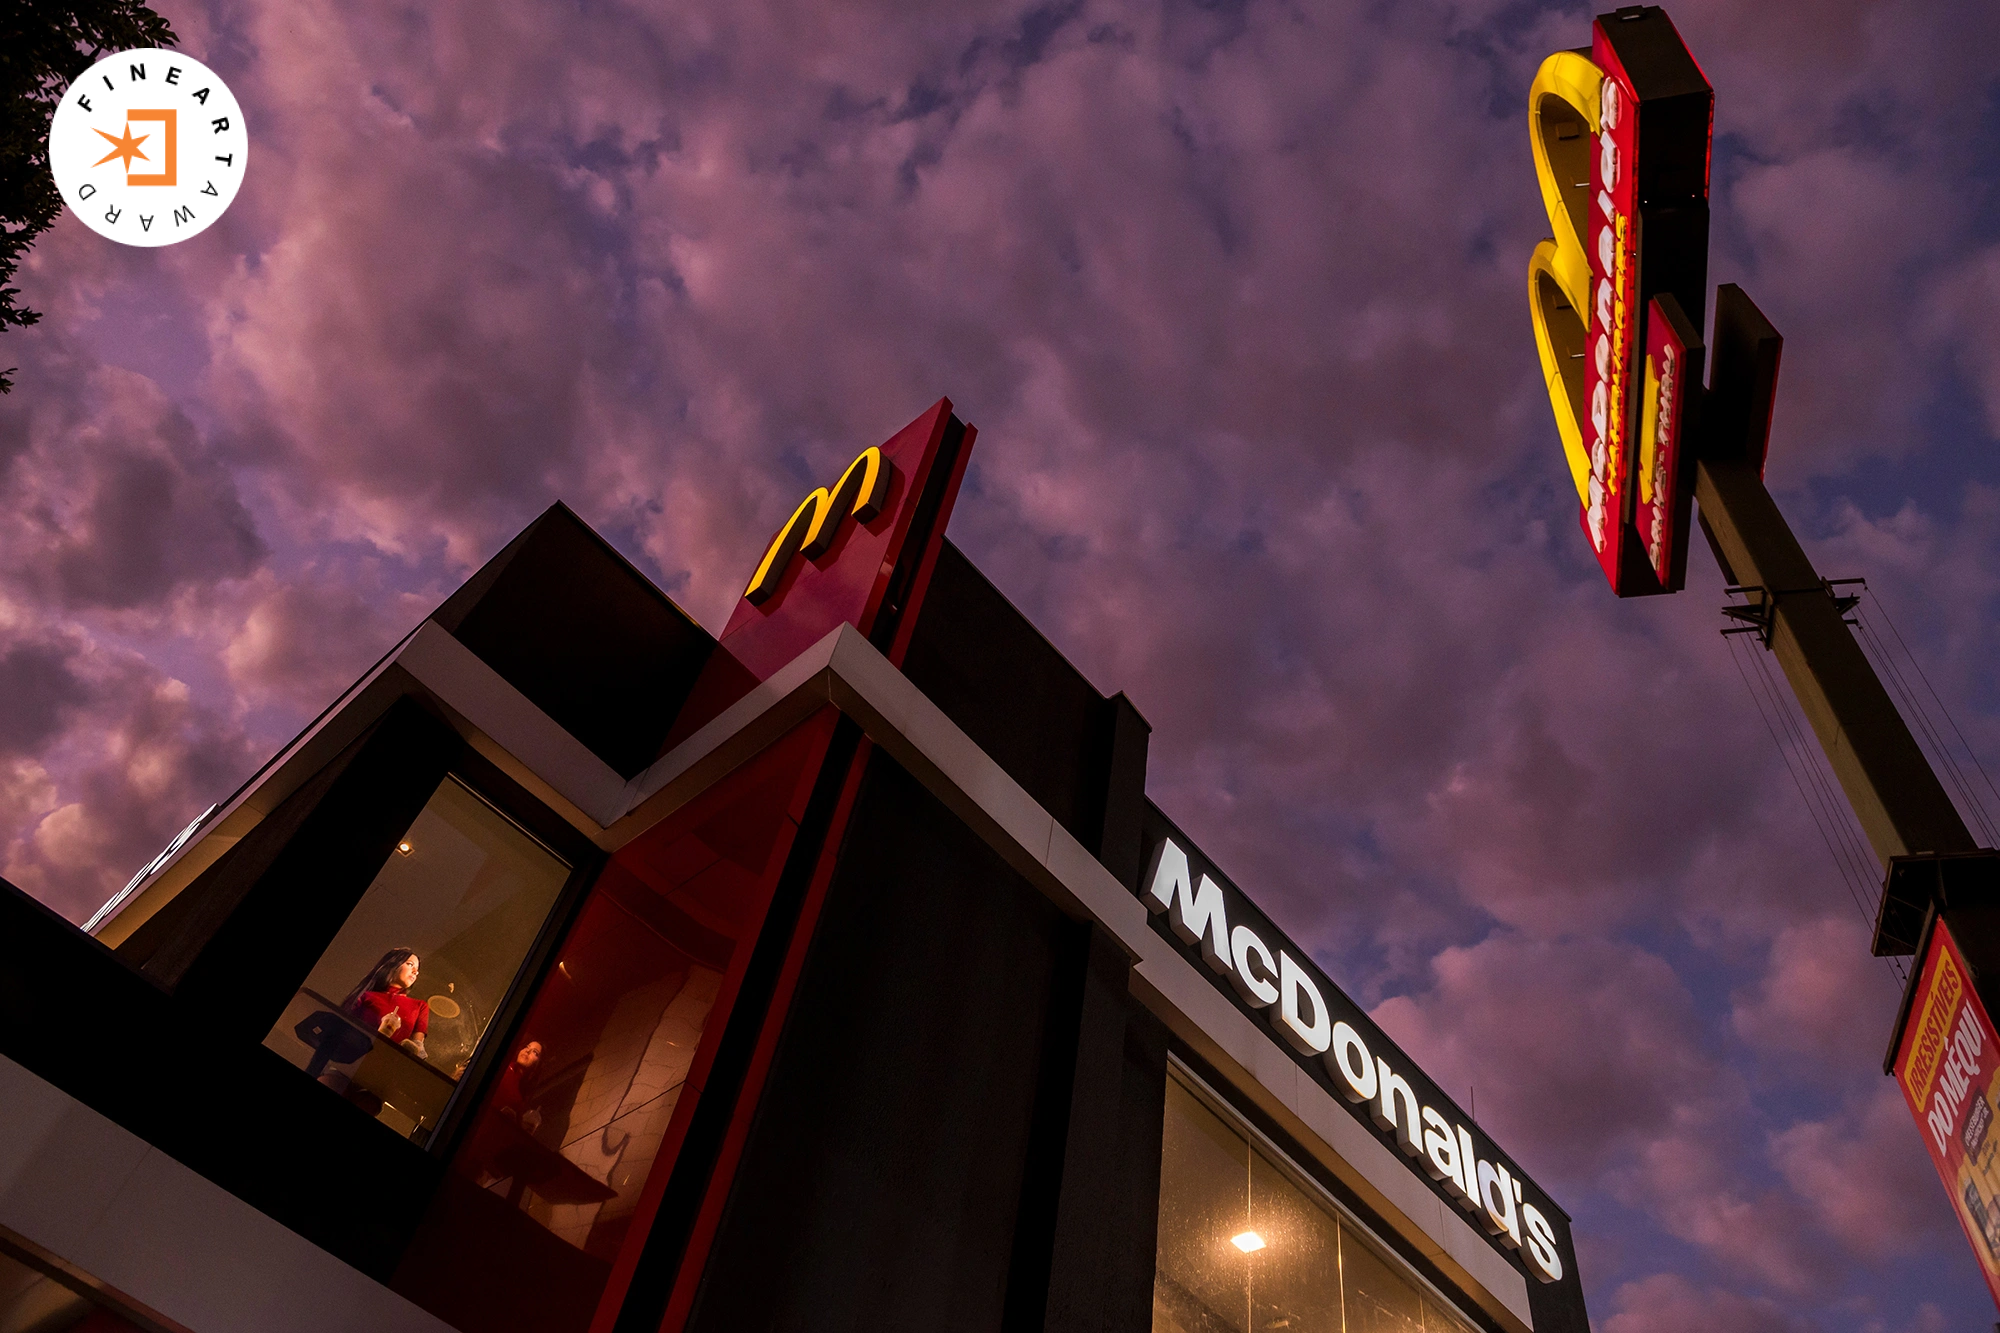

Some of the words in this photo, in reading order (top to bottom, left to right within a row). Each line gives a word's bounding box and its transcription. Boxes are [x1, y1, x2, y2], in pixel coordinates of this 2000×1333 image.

[1147, 837, 1563, 1283] McDonald's
[1909, 959, 1962, 1102] IRRESISTÍVEIS
[1939, 998, 1987, 1118] MÉQUI
[1927, 1091, 1954, 1157] DO
